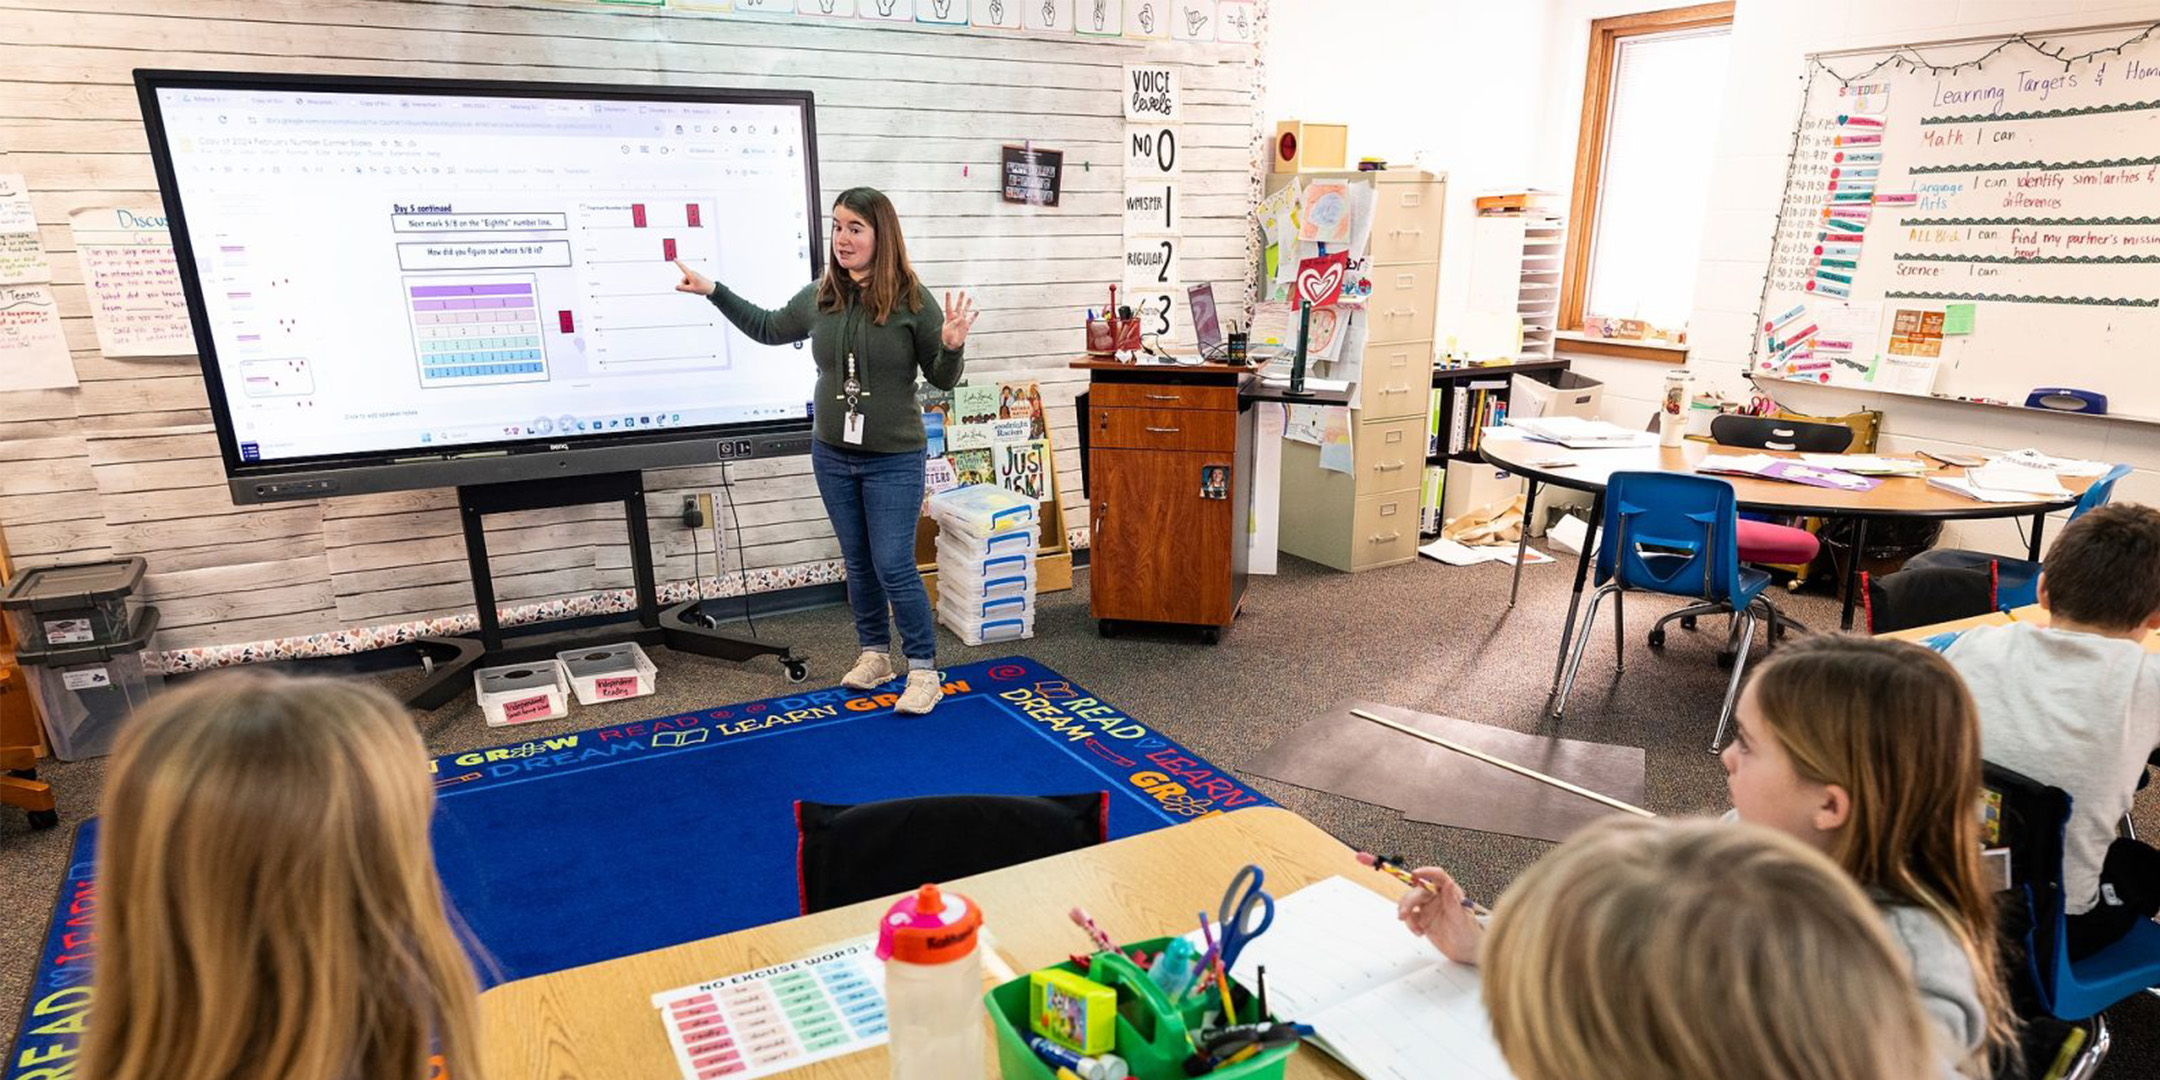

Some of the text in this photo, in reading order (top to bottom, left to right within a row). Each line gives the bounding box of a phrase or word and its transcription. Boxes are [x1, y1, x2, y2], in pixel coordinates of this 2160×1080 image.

[1132, 70, 1170, 93] VOICE
[1933, 80, 2005, 115] Learning
[2018, 71, 2078, 99] Targets
[1132, 91, 1172, 115] levels
[254, 138, 288, 148] February
[290, 138, 321, 146] Number
[1921, 128, 2016, 148] Math I can
[1133, 129, 1175, 172] NO 0
[1911, 179, 1964, 198] Language
[1974, 176, 1979, 190] I
[1984, 178, 2007, 188] can
[2017, 172, 2064, 189] identify
[2072, 169, 2140, 186] similarities
[393, 203, 452, 214] Day 5 continued
[1126, 186, 1171, 228] WHISPER 1
[1920, 191, 2062, 210] Arts differences
[408, 219, 425, 228] Next
[426, 219, 443, 228] mark
[444, 219, 458, 228] 5/8
[469, 219, 479, 227] the
[513, 218, 537, 227] number
[1967, 228, 1972, 241] I
[1978, 230, 1998, 240] can
[2011, 228, 2037, 245] find
[2043, 233, 2061, 248] my
[2066, 233, 2118, 249] partner's
[427, 248, 441, 256] How
[443, 247, 454, 256] did
[455, 248, 467, 257] you
[467, 247, 486, 257] figure
[488, 247, 499, 255] out
[499, 246, 518, 255] where
[519, 246, 533, 255] 5/8
[1127, 241, 1172, 283] REGULAR 2
[2014, 247, 2041, 257] heart
[1897, 263, 1998, 276] Science I can
[7, 288, 41, 301] Teams
[1157, 295, 1171, 335] 3
[1002, 443, 1044, 476] JUST
[1004, 473, 1044, 500] ASK!
[597, 678, 633, 690] Independent
[602, 687, 629, 697] Reading
[599, 704, 838, 742] READ LEARN
[999, 688, 1094, 742] DREAM
[487, 741, 646, 778] DREAM
[1062, 697, 1258, 806] READ LEARN
[699, 943, 871, 992] NO EXCUSE WORDS
